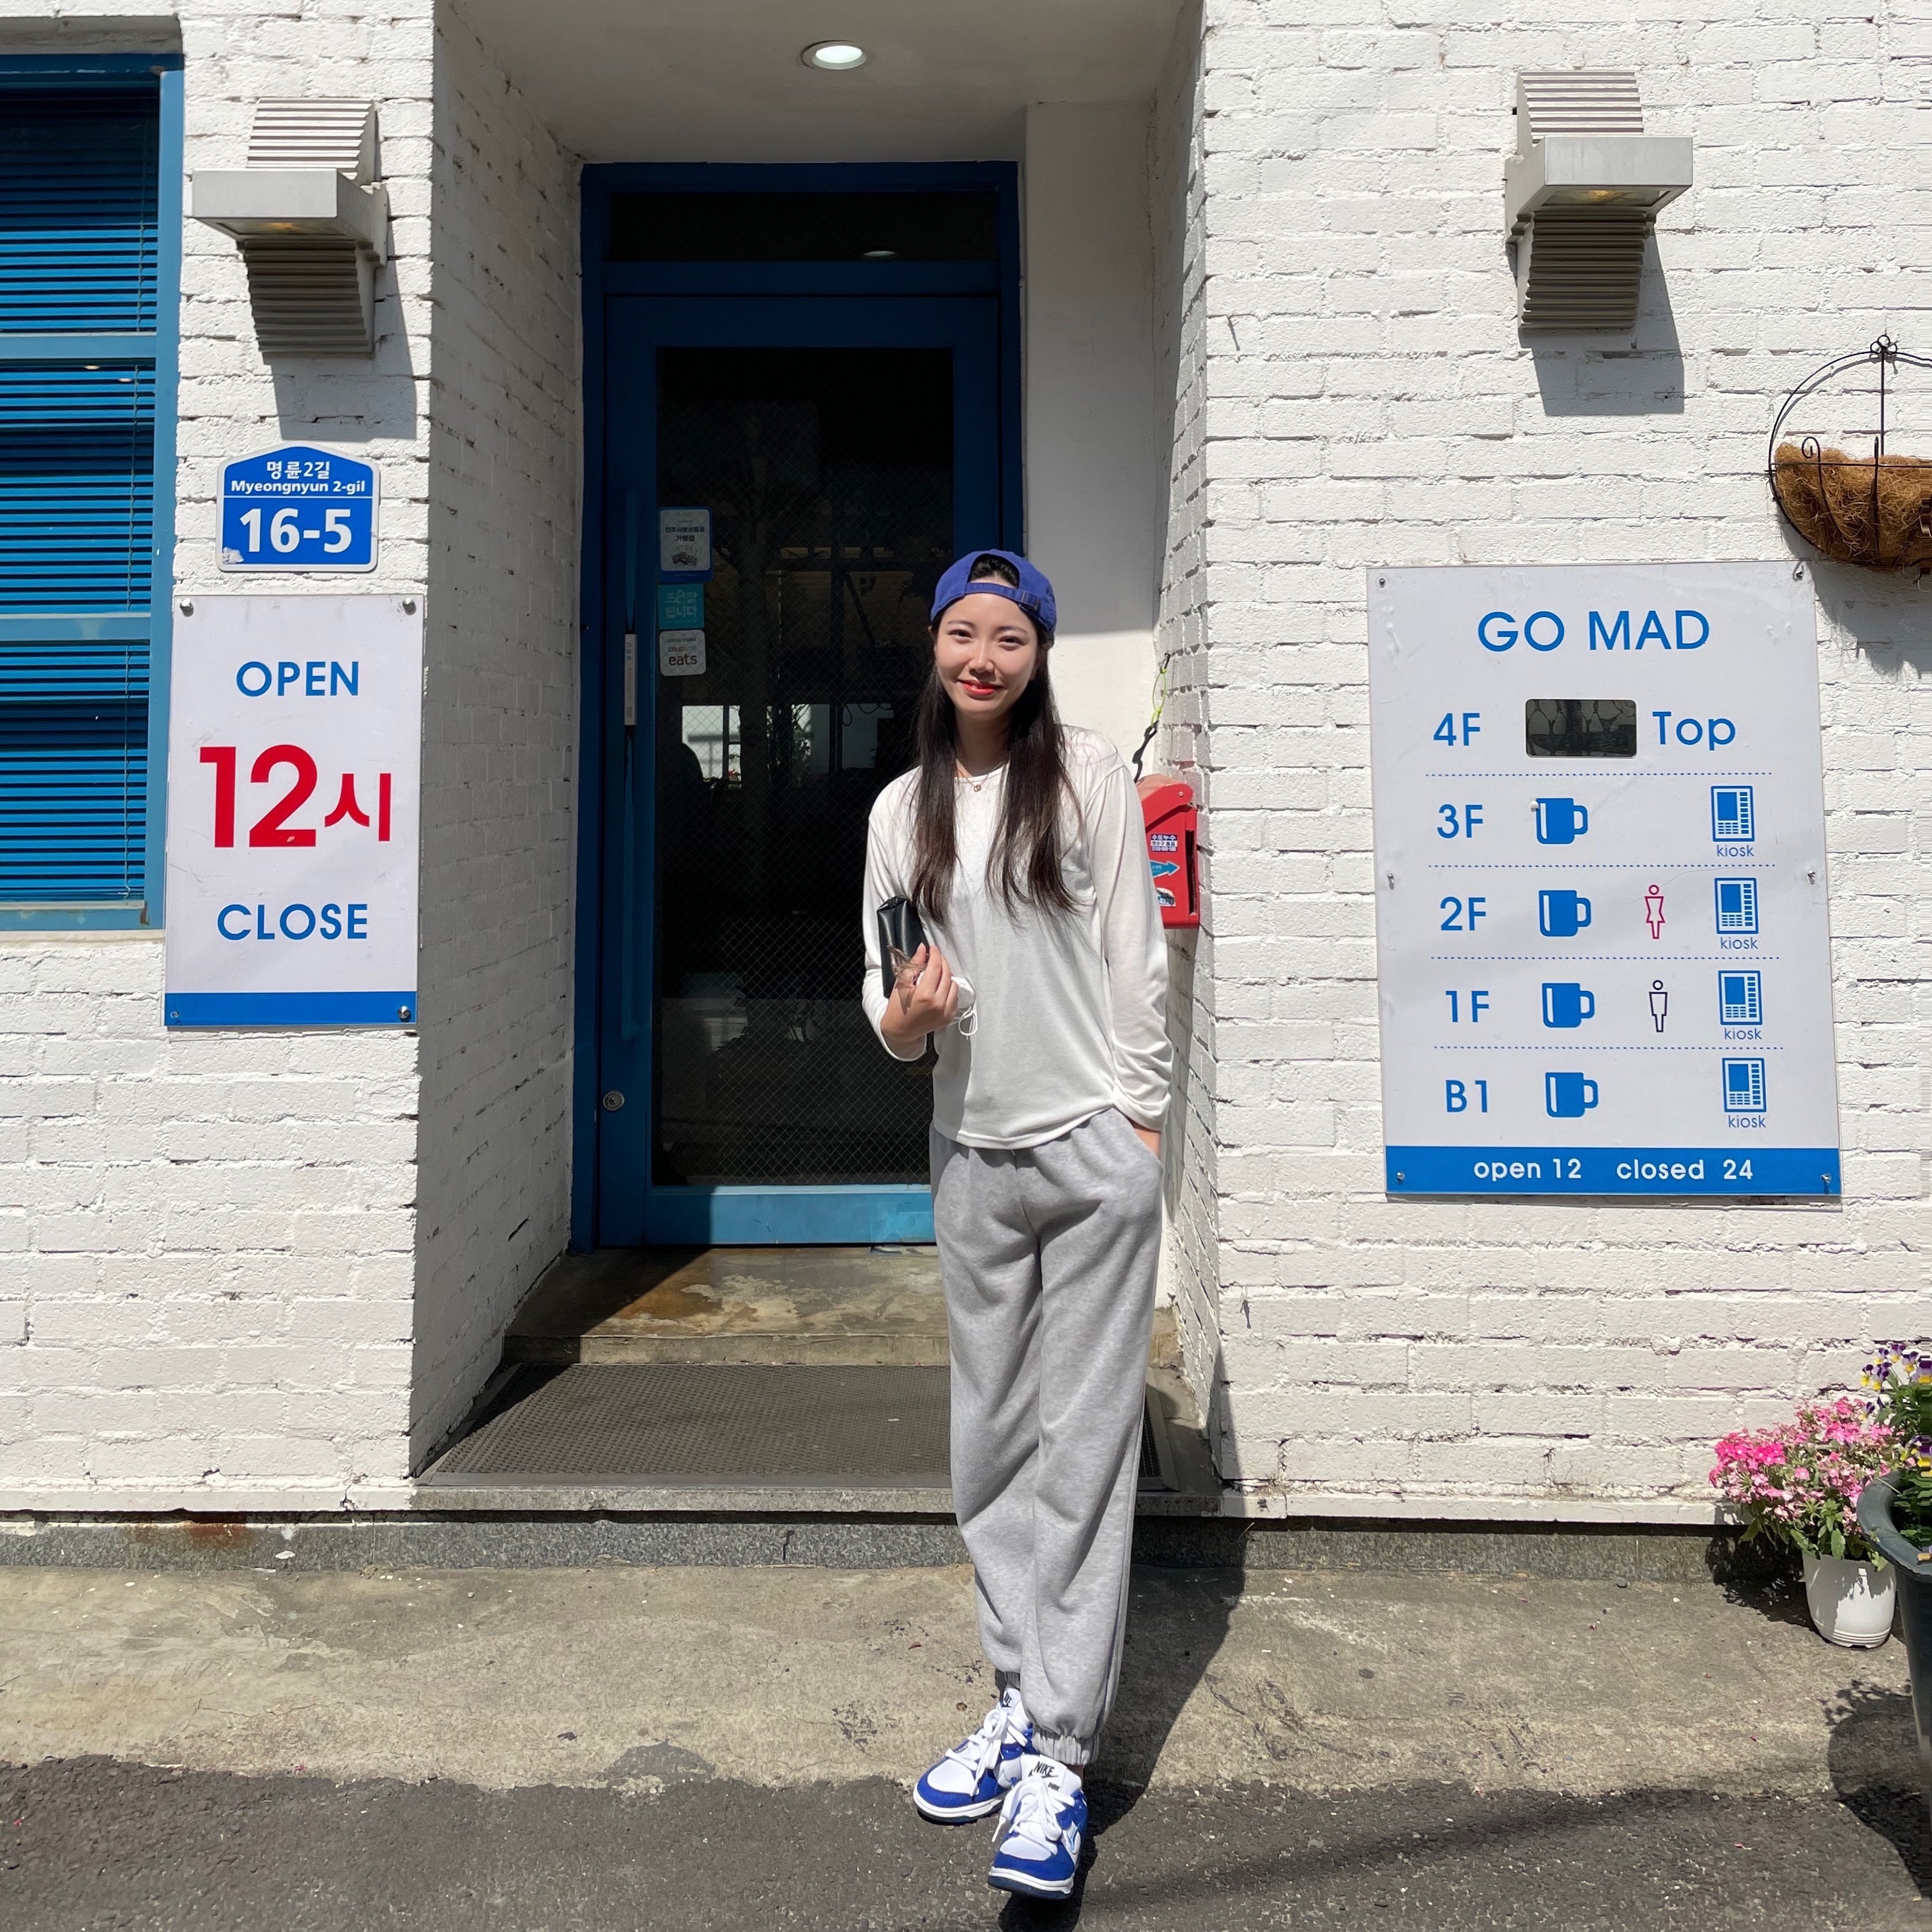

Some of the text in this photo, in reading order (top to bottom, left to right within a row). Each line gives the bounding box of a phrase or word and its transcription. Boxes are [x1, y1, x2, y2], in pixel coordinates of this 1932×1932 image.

[268, 461, 329, 479] 명륜2길
[232, 481, 364, 494] Myeongnyun 2-gil
[238, 509, 351, 553] 16-5
[1478, 610, 1709, 652] GO MAD
[669, 654, 697, 666] eats
[236, 661, 358, 696] OPEN
[1434, 711, 1736, 751] 4F Top
[201, 745, 391, 847] 12시
[1438, 804, 1483, 838] 3F
[1717, 845, 1754, 858] kiosk
[217, 903, 367, 940] CLOSE
[1441, 896, 1486, 930] 2F
[1720, 937, 1758, 951] kiosk
[1446, 991, 1489, 1022] 1F
[1724, 1027, 1762, 1040] kiosk
[1446, 1080, 1487, 1112] B1
[1728, 1115, 1766, 1128] kiosk
[1475, 1159, 1752, 1181] open 12 closed 24
[1033, 1761, 1055, 1776] NIKE
